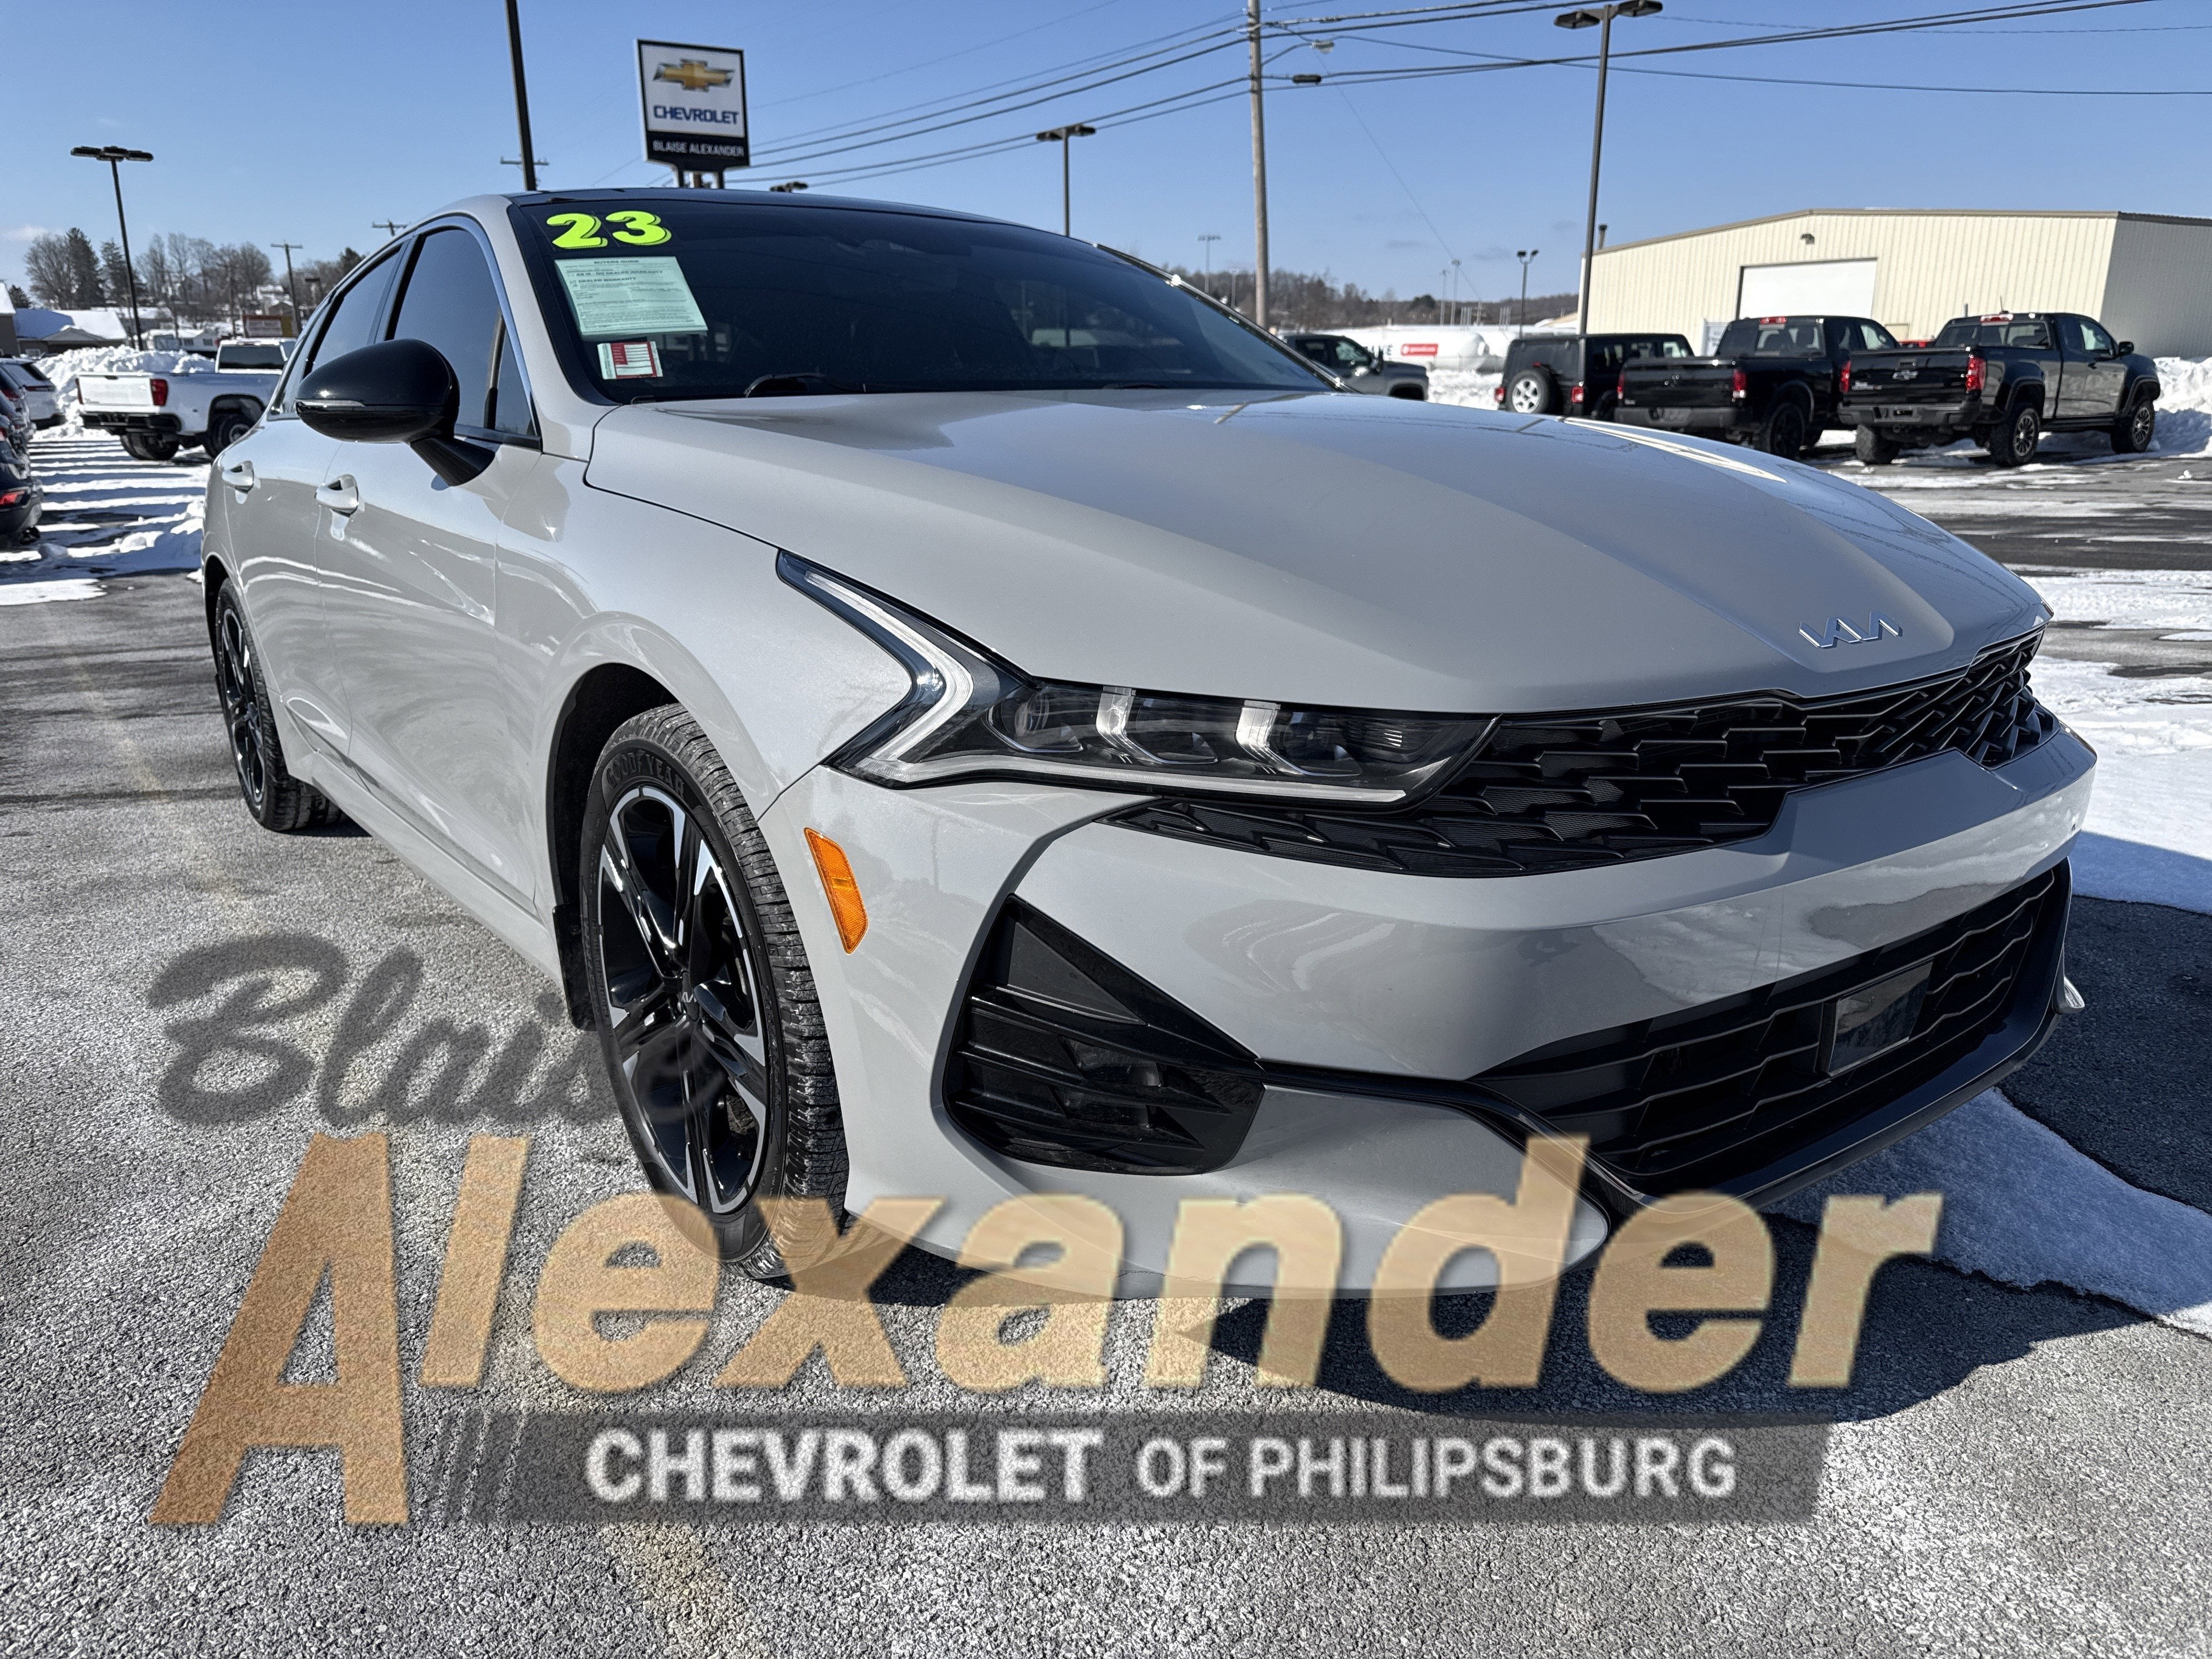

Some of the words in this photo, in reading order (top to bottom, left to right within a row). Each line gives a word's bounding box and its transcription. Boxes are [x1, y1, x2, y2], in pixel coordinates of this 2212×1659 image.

[653, 105, 740, 125] CHEVROLET
[652, 140, 687, 154] BLAISE
[689, 142, 744, 157] ALEXANDER
[546, 211, 672, 249] 23
